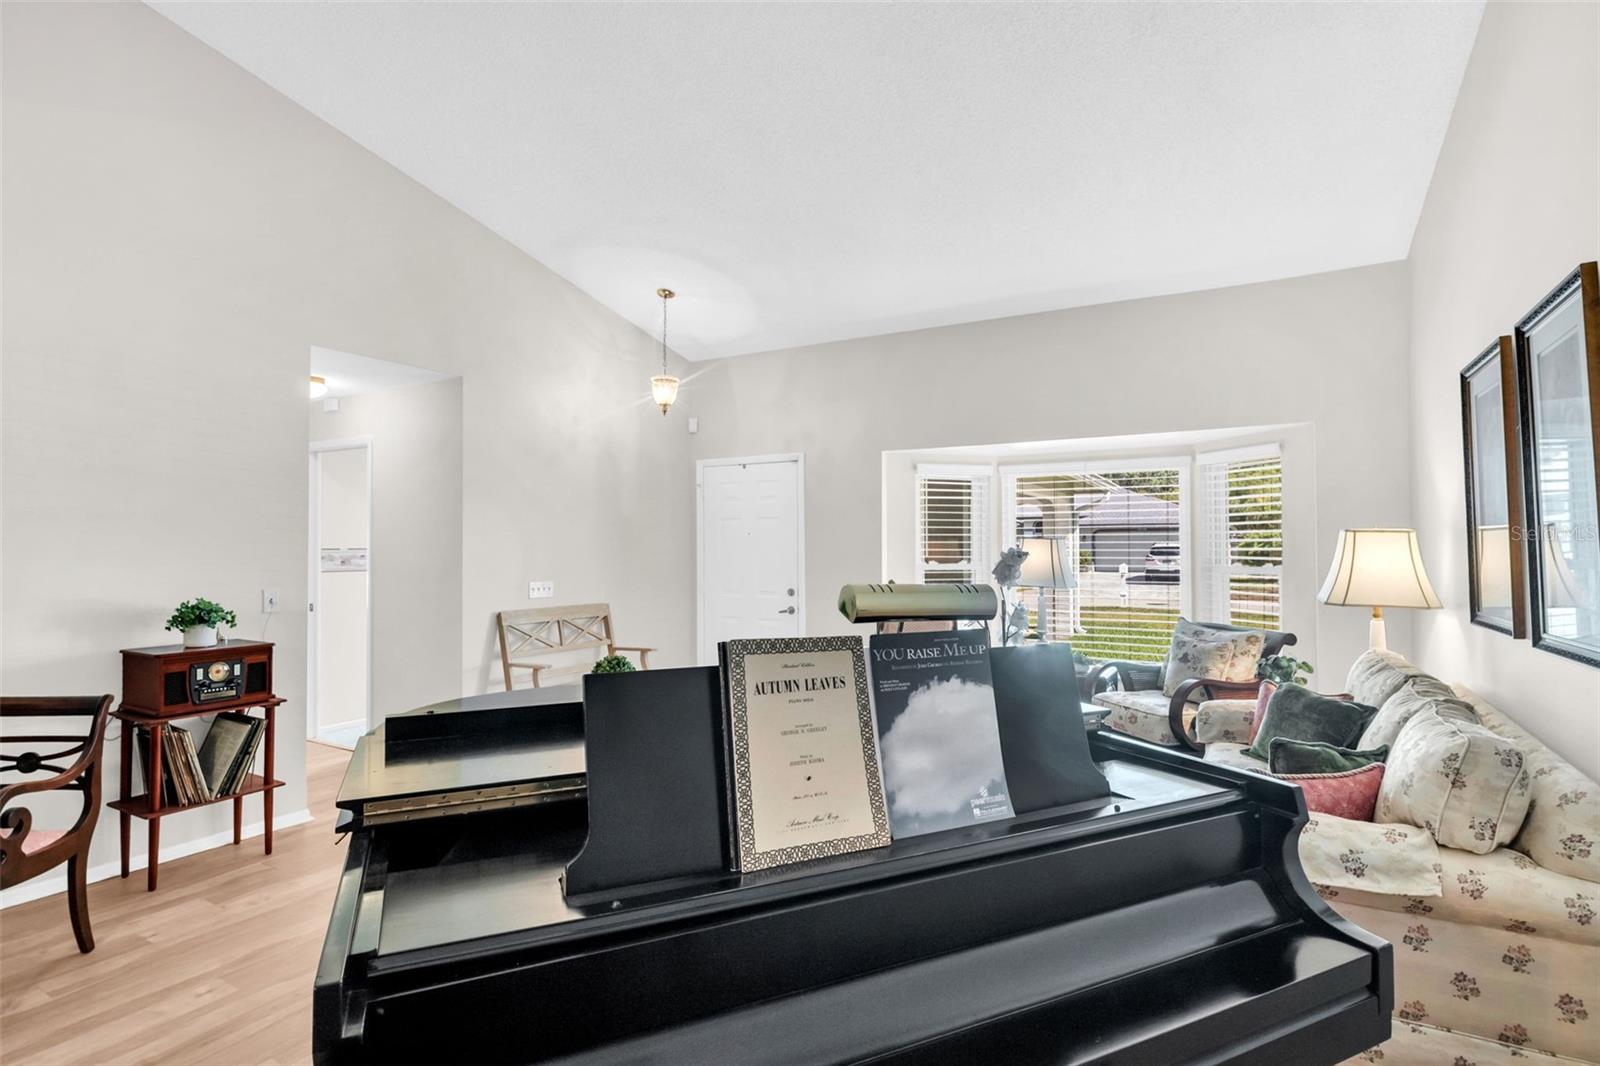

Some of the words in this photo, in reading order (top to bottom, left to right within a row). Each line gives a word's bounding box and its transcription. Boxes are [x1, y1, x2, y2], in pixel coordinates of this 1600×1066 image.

[873, 647, 904, 661] YOU
[907, 647, 942, 660] RAISE
[968, 644, 986, 655] UP
[753, 679, 801, 696] AUTUMN
[804, 675, 846, 692] LEAVES
